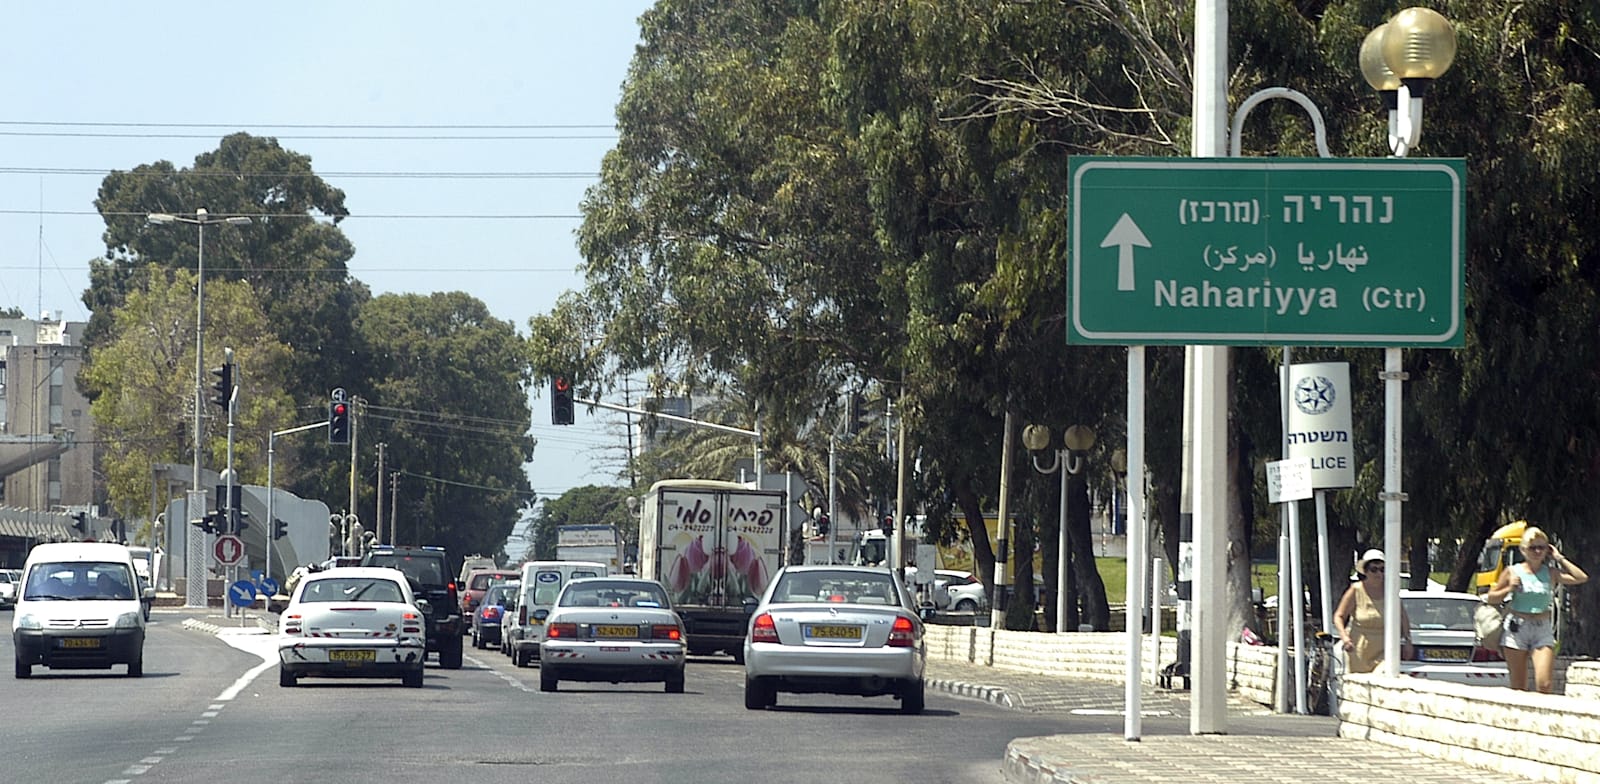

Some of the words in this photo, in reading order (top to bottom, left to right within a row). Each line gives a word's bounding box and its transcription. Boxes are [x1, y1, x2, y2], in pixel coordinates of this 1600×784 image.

[1178, 198, 1260, 225] (מרכז)
[1283, 195, 1394, 224] נהריה
[1203, 244, 1277, 272] (مركز)
[1297, 241, 1369, 273] نهاريا
[1154, 279, 1338, 314] Nahariyya
[1361, 286, 1426, 313] (Ctr)
[1287, 430, 1348, 445] משטרה
[1311, 456, 1347, 470] LICE
